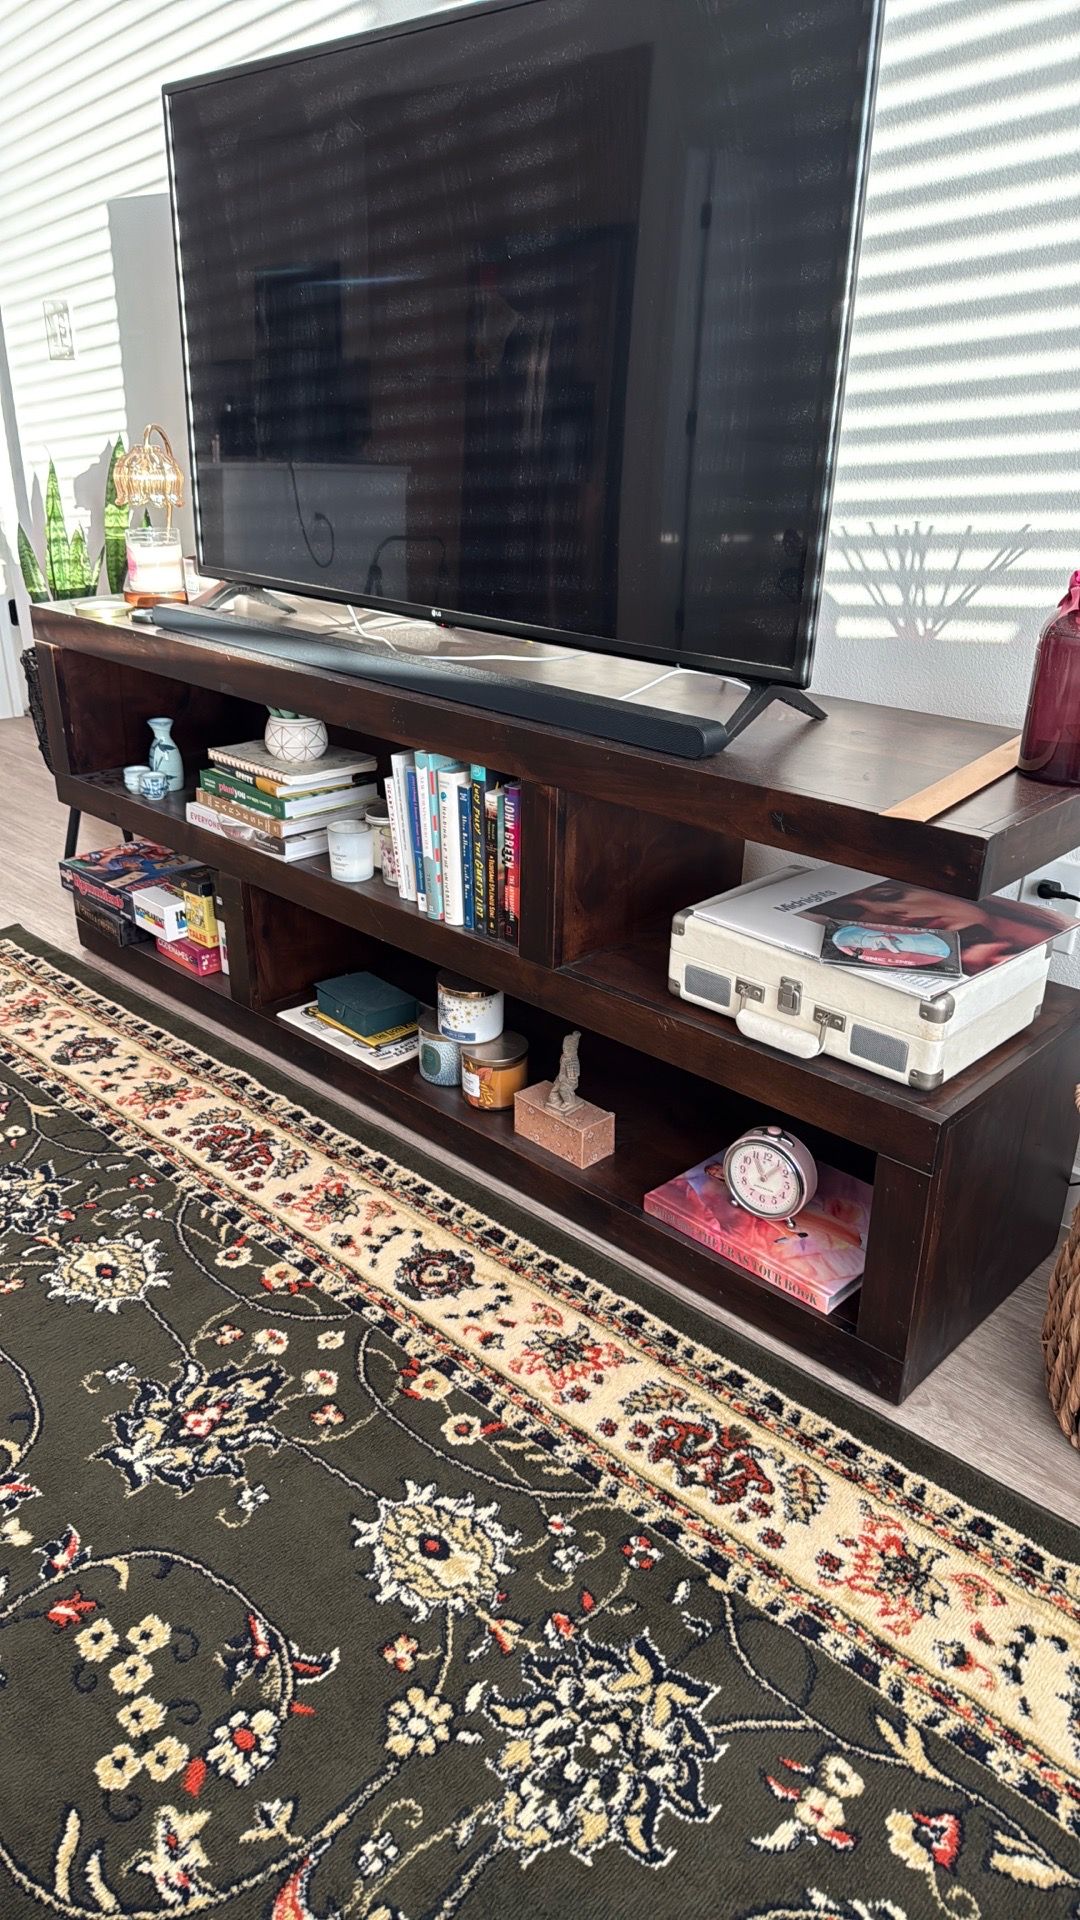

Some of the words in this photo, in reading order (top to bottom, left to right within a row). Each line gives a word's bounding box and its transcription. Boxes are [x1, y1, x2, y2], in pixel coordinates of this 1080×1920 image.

[473, 783, 481, 804] LUCY
[214, 801, 265, 826] HARVEST
[504, 798, 515, 829] JOHN
[473, 806, 482, 835] FOLEY
[504, 831, 515, 869] GREEN
[474, 859, 484, 896] GUEST
[773, 889, 838, 912] Midnights
[475, 896, 484, 918] LIST
[743, 1155, 752, 1165] 10
[752, 1151, 759, 1160] 11
[763, 1152, 773, 1162] 12
[740, 1165, 746, 1174] 9
[782, 1169, 789, 1179] 2
[741, 1176, 748, 1186] 8
[784, 1181, 790, 1190] 3
[749, 1187, 756, 1196] 7
[779, 1191, 786, 1200] 4
[759, 1194, 766, 1204] 6
[771, 1196, 778, 1205] 5
[720, 1240, 749, 1267] ERAS
[752, 1261, 783, 1285] TOUR
[784, 1278, 818, 1306] BOOK
